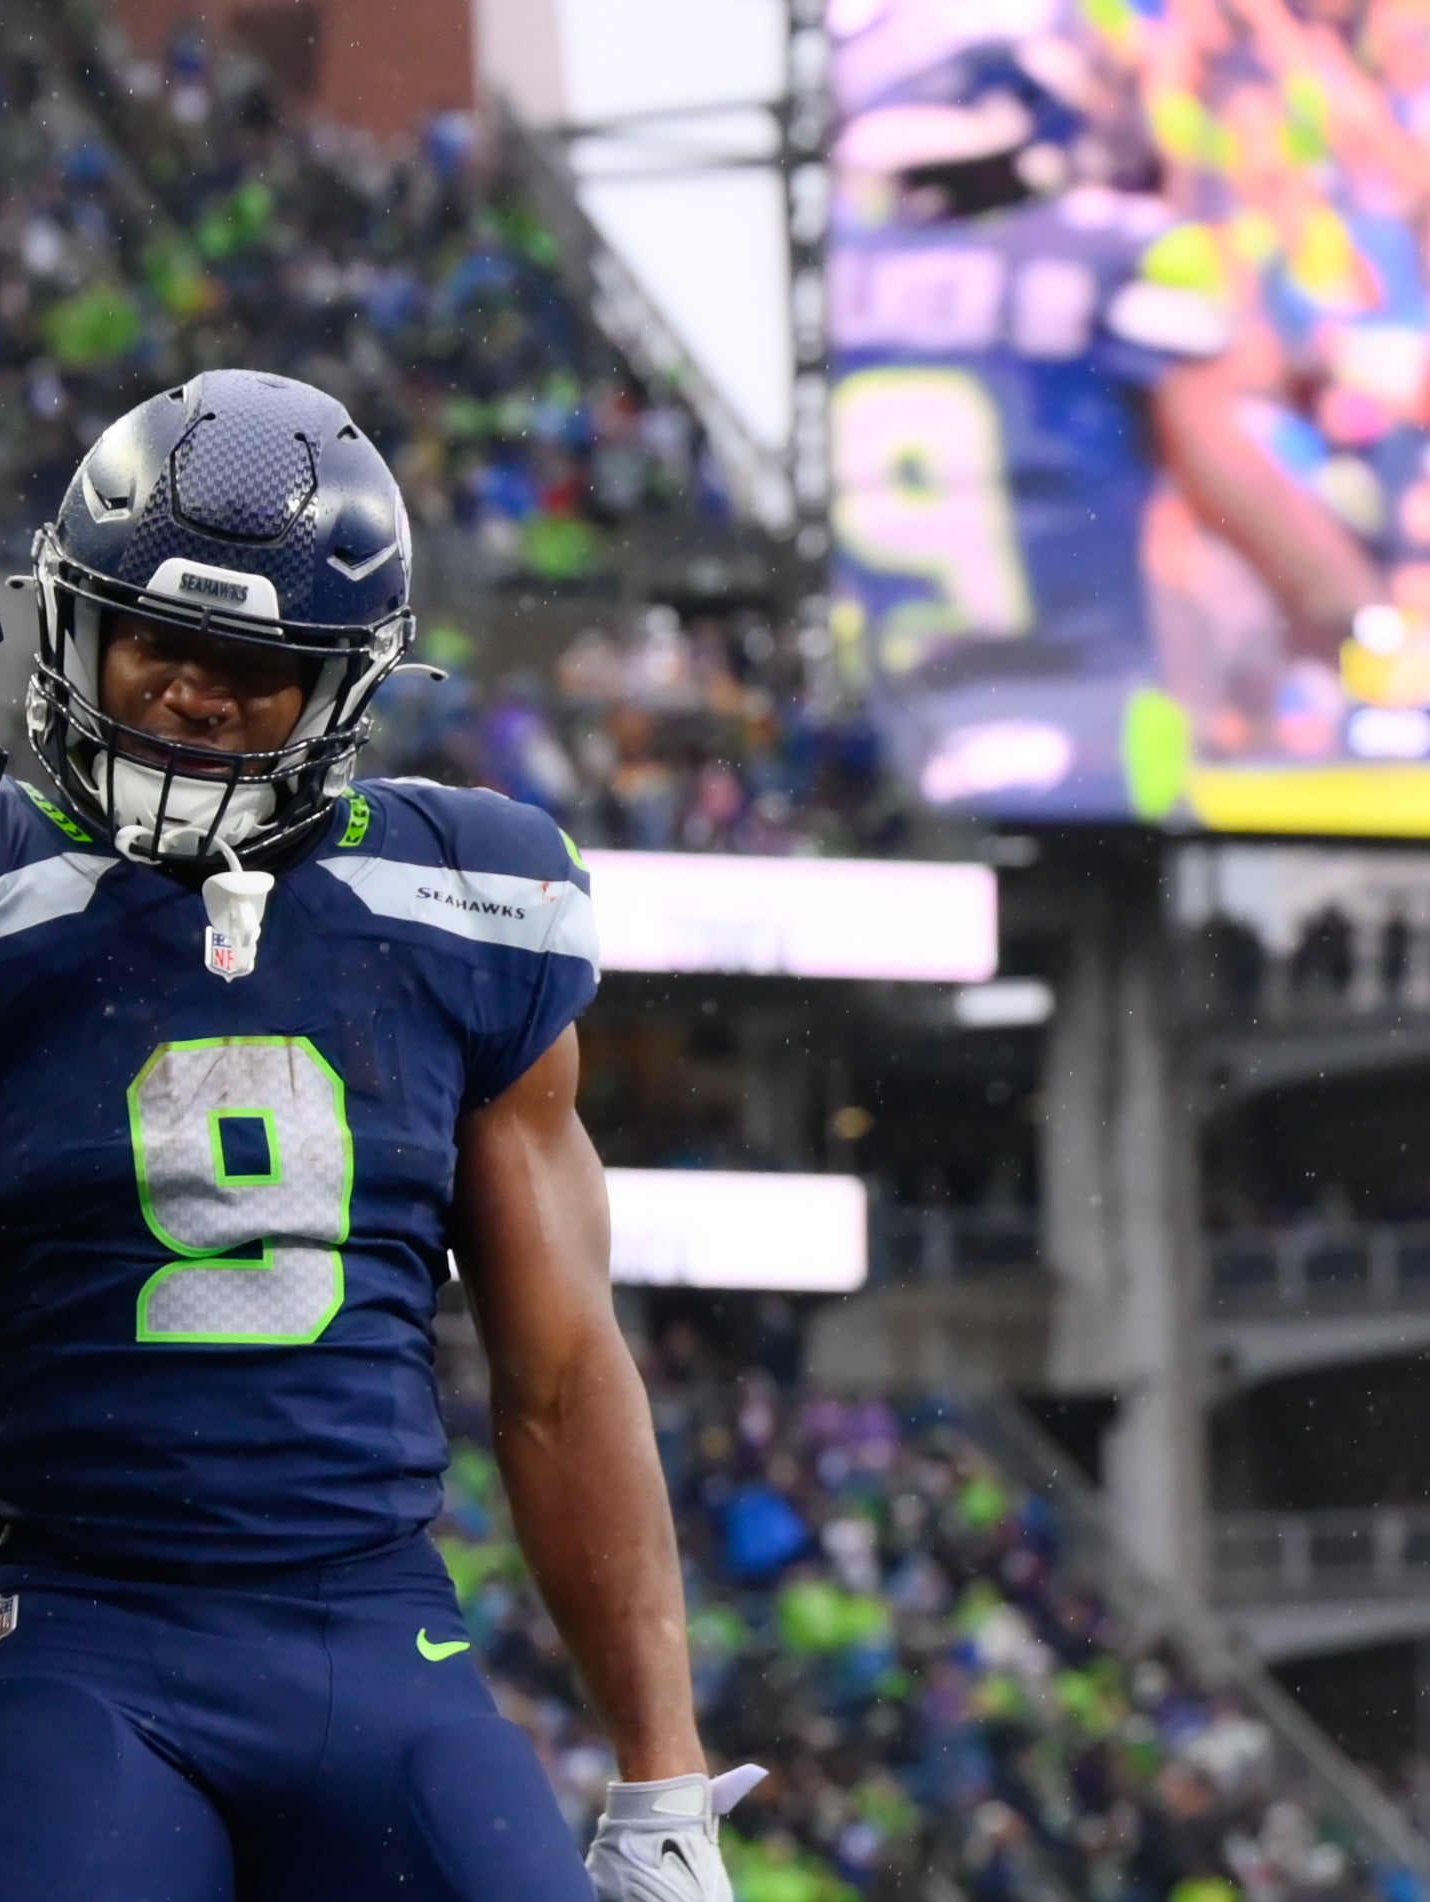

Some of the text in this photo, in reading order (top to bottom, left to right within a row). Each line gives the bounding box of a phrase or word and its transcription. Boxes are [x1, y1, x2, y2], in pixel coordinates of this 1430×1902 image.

[179, 572, 249, 602] SEAHAWKS
[416, 886, 526, 920] SEAHAWKS
[126, 1035, 355, 1344] 9
